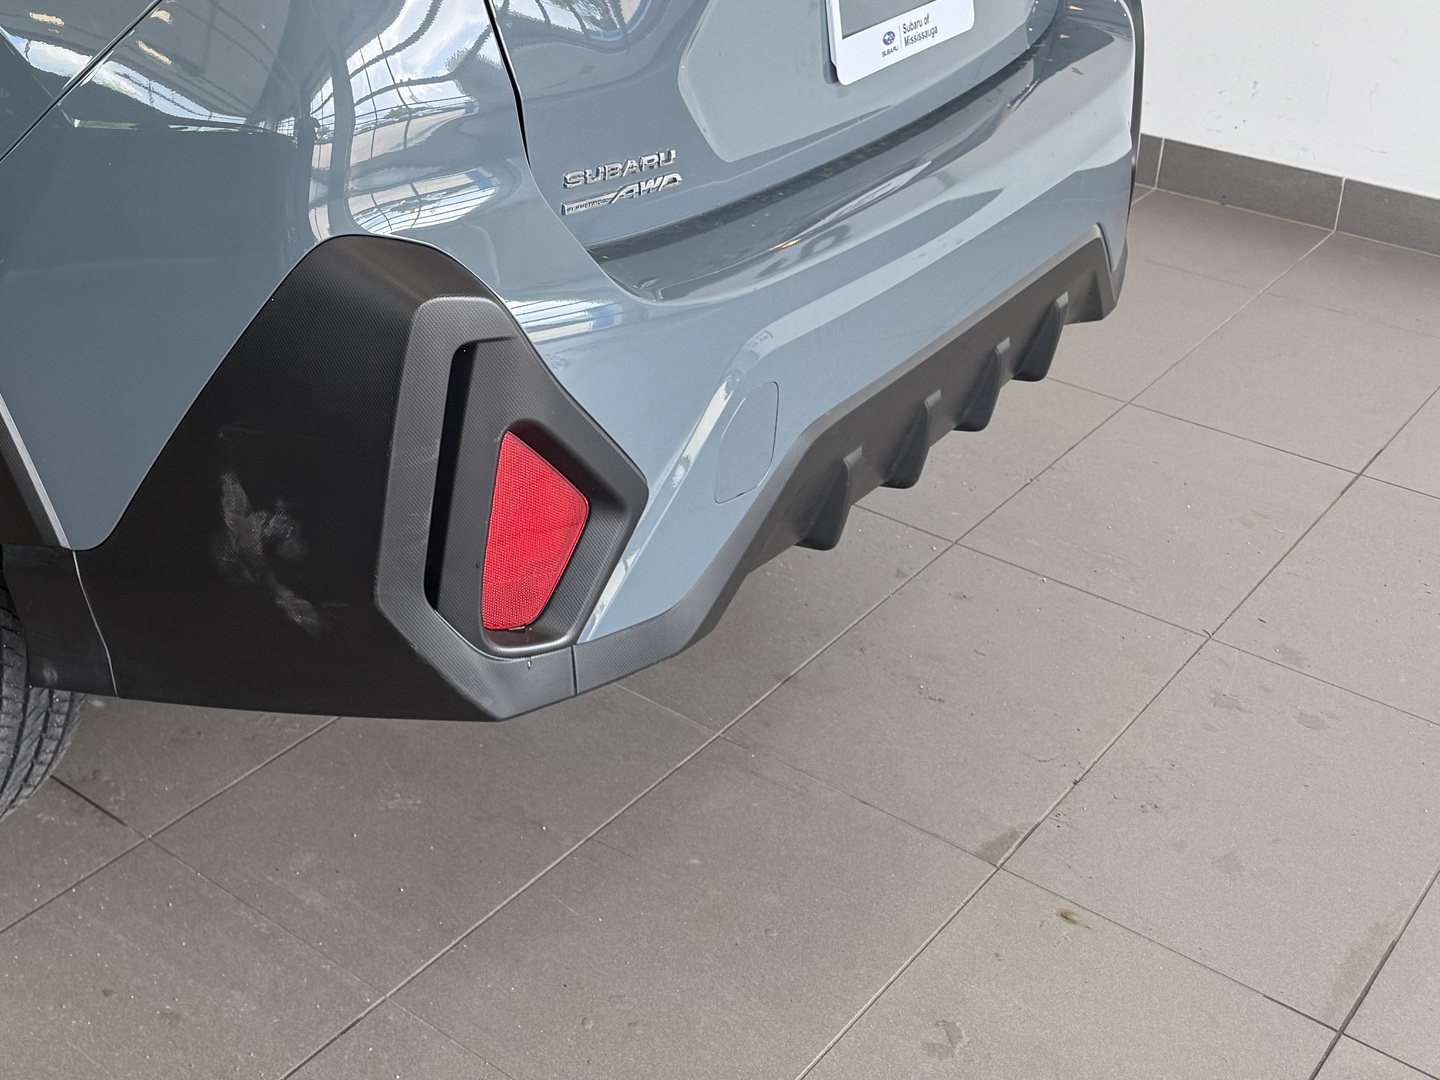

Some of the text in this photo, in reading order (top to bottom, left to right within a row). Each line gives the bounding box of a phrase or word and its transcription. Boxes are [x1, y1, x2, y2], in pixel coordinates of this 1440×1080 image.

[902, 14, 930, 35] Subaru of
[904, 26, 938, 48] Mississauga
[882, 45, 899, 58] SUBARU
[563, 148, 676, 189] SUBARU
[610, 172, 682, 204] AWD
